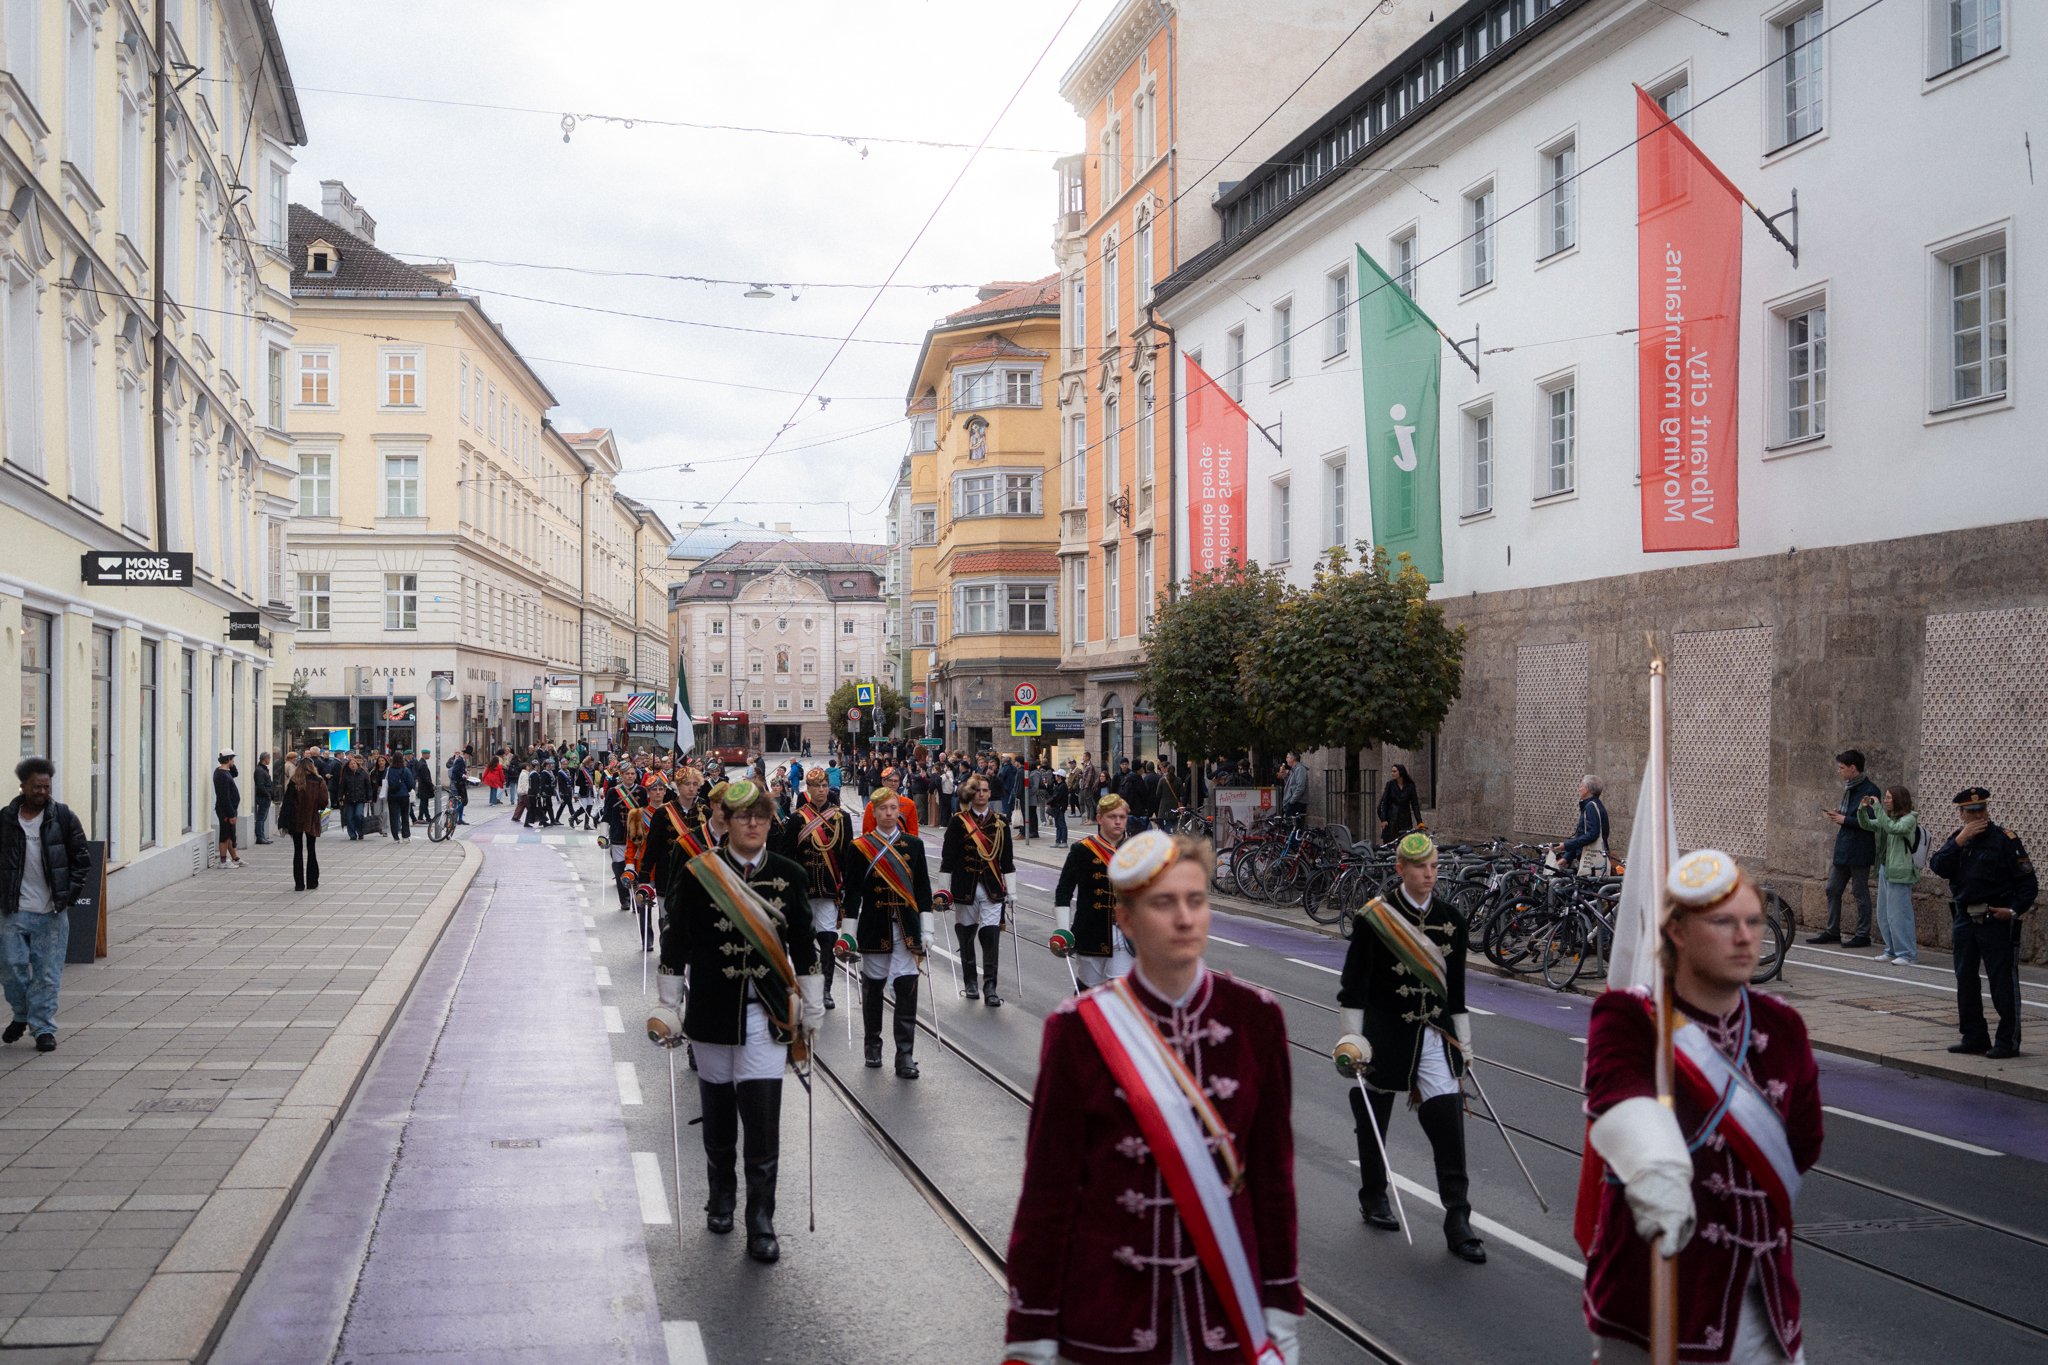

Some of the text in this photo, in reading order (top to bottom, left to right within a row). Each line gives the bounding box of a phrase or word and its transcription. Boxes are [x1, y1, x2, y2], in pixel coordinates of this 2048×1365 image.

[125, 557, 169, 569] MONS
[125, 569, 182, 581] ROYALE
[294, 667, 416, 677] ABAK ARREN
[1020, 688, 1032, 700] 30
[633, 723, 638, 732] J
